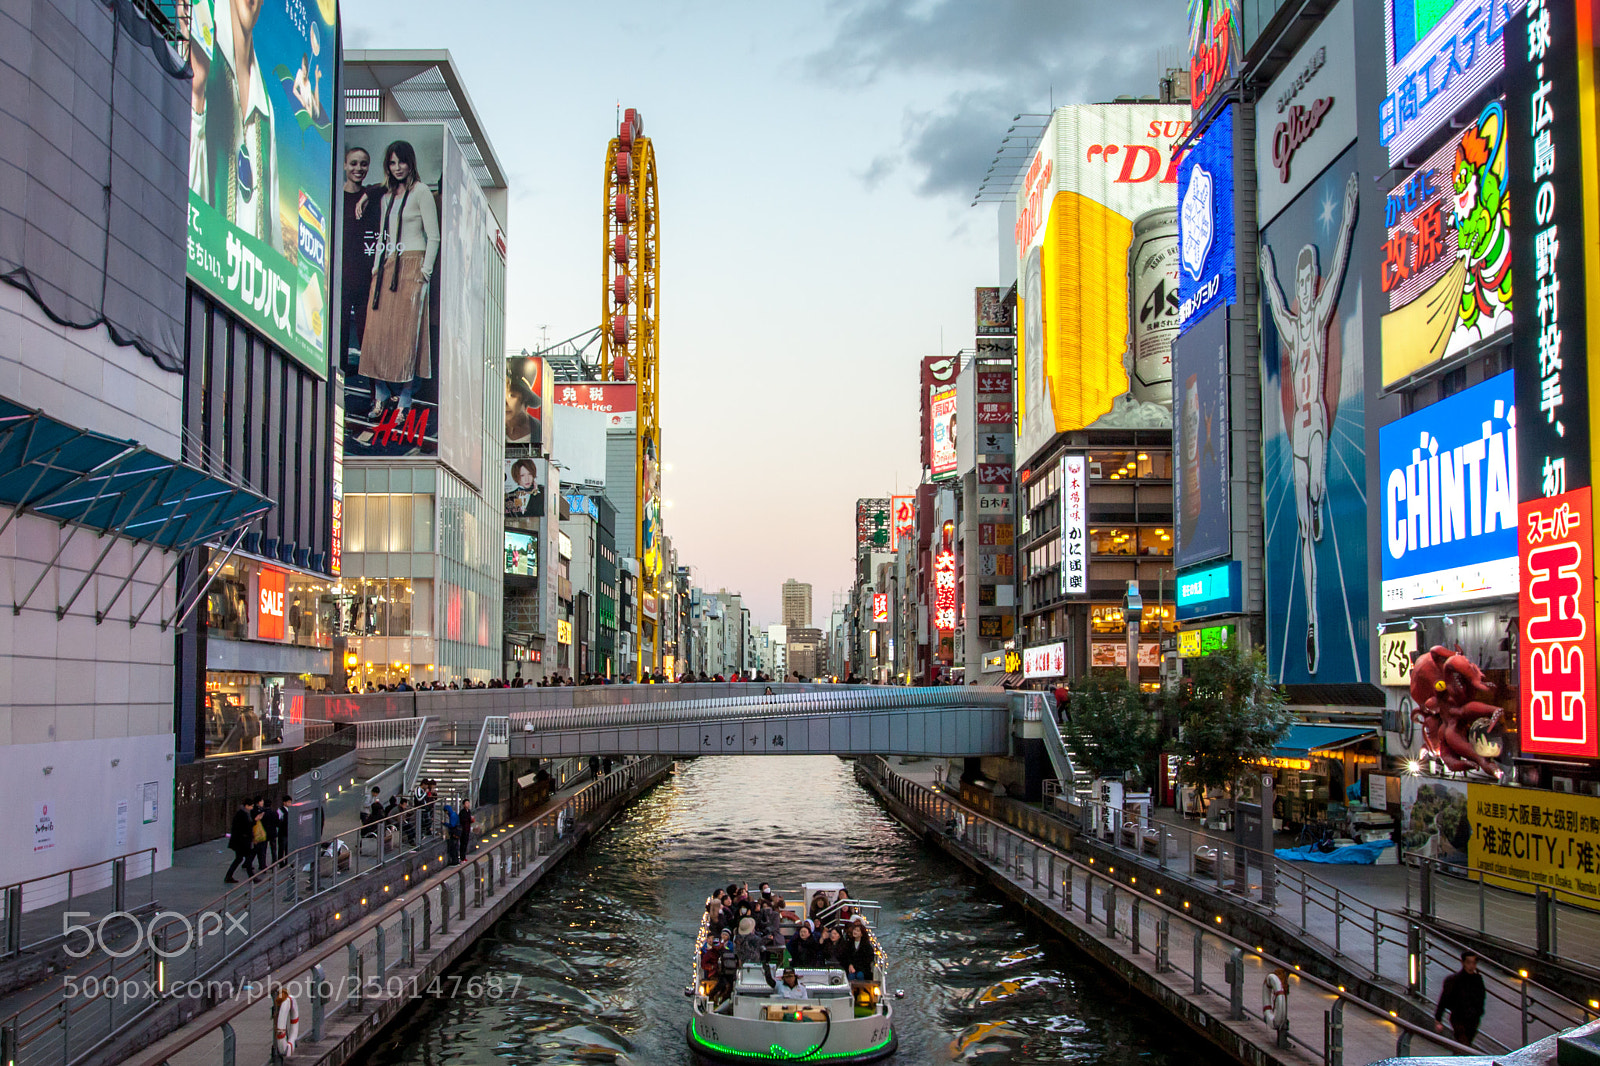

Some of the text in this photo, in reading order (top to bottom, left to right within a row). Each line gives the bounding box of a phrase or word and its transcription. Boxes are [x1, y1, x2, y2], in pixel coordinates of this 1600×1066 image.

[1190, 7, 1231, 109] ピップ
[1272, 97, 1334, 183] Glico
[1385, 168, 1437, 229] かぜに
[300, 222, 324, 267] サロンパス
[363, 242, 406, 257] ¥999
[1381, 200, 1443, 293] 改源
[226, 231, 292, 337] サロンパス
[562, 387, 604, 401] 免税
[1300, 342, 1312, 429] グリコ
[372, 408, 430, 447] H&M
[1527, 503, 1581, 544] スーパー
[1068, 526, 1083, 588] かに道楽
[260, 588, 284, 617] SALE
[1528, 540, 1587, 744] 玉出
[701, 735, 785, 747] えびす橋
